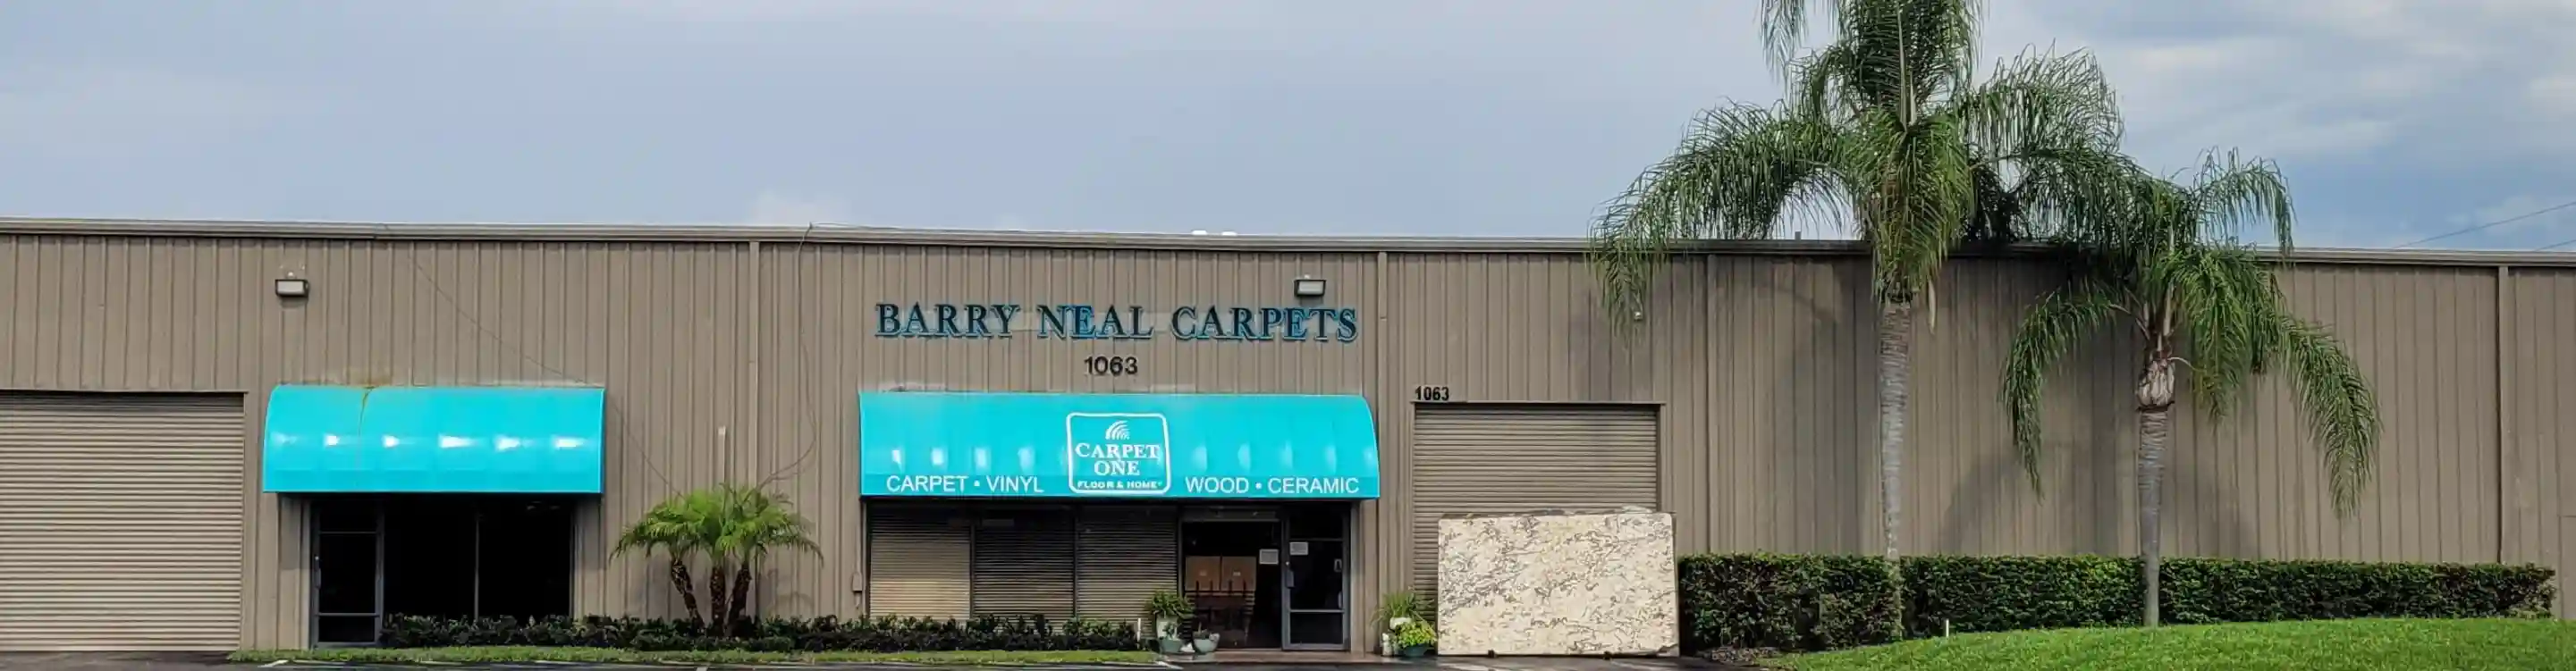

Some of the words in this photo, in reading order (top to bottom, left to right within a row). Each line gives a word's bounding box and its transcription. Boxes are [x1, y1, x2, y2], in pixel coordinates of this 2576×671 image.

[874, 301, 1020, 339] BARRY
[1036, 305, 1153, 340] NEAL
[1171, 305, 1357, 342] CARPETS
[1084, 356, 1138, 375] 1063
[1415, 385, 1449, 401] 1063
[1075, 442, 1160, 458] CARPET
[1094, 460, 1140, 476] ONE
[886, 475, 969, 492] CARPET
[985, 475, 1044, 492] VINYL
[1077, 480, 1114, 490] FLOOR
[1185, 476, 1249, 494] WOOD
[1267, 476, 1360, 494] CERAMIC
